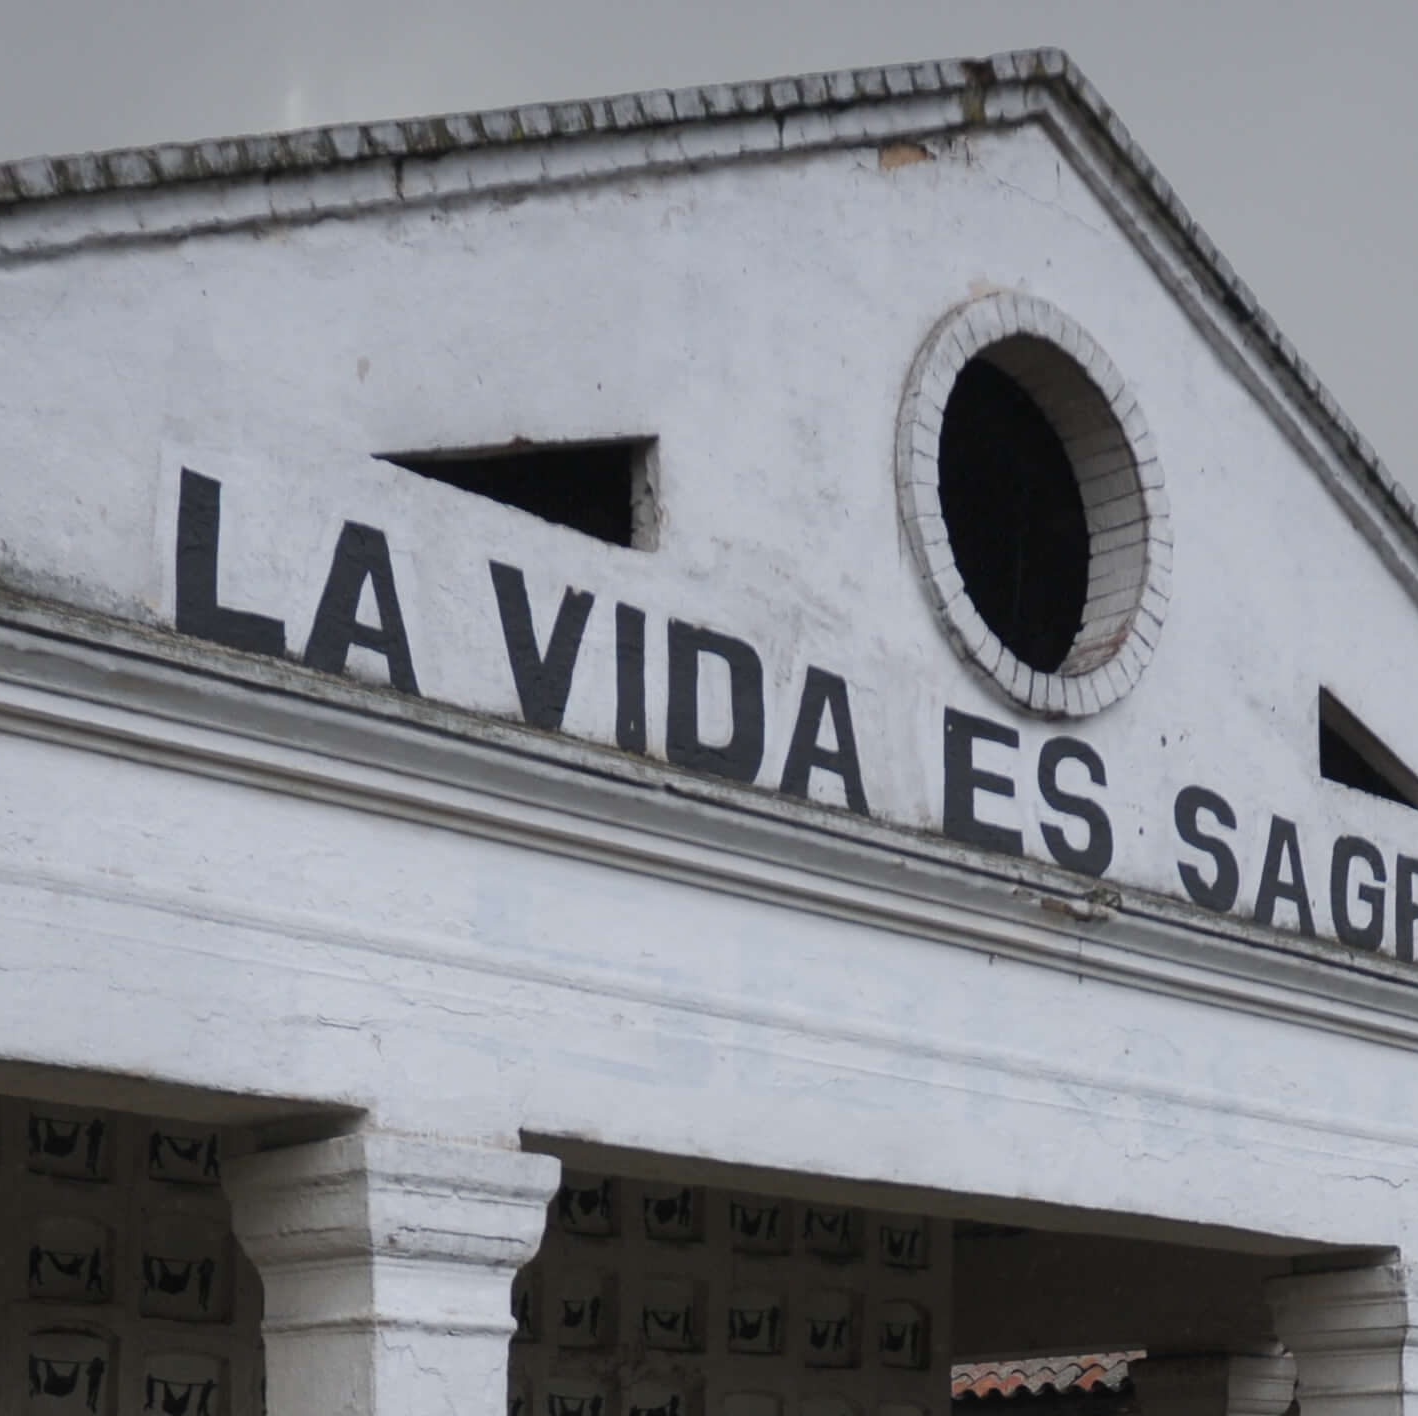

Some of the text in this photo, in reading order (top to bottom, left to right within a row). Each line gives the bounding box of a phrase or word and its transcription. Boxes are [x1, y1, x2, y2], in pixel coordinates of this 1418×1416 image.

[175, 466, 422, 698] LA
[489, 560, 871, 817] VIDA
[942, 706, 1114, 878] ES
